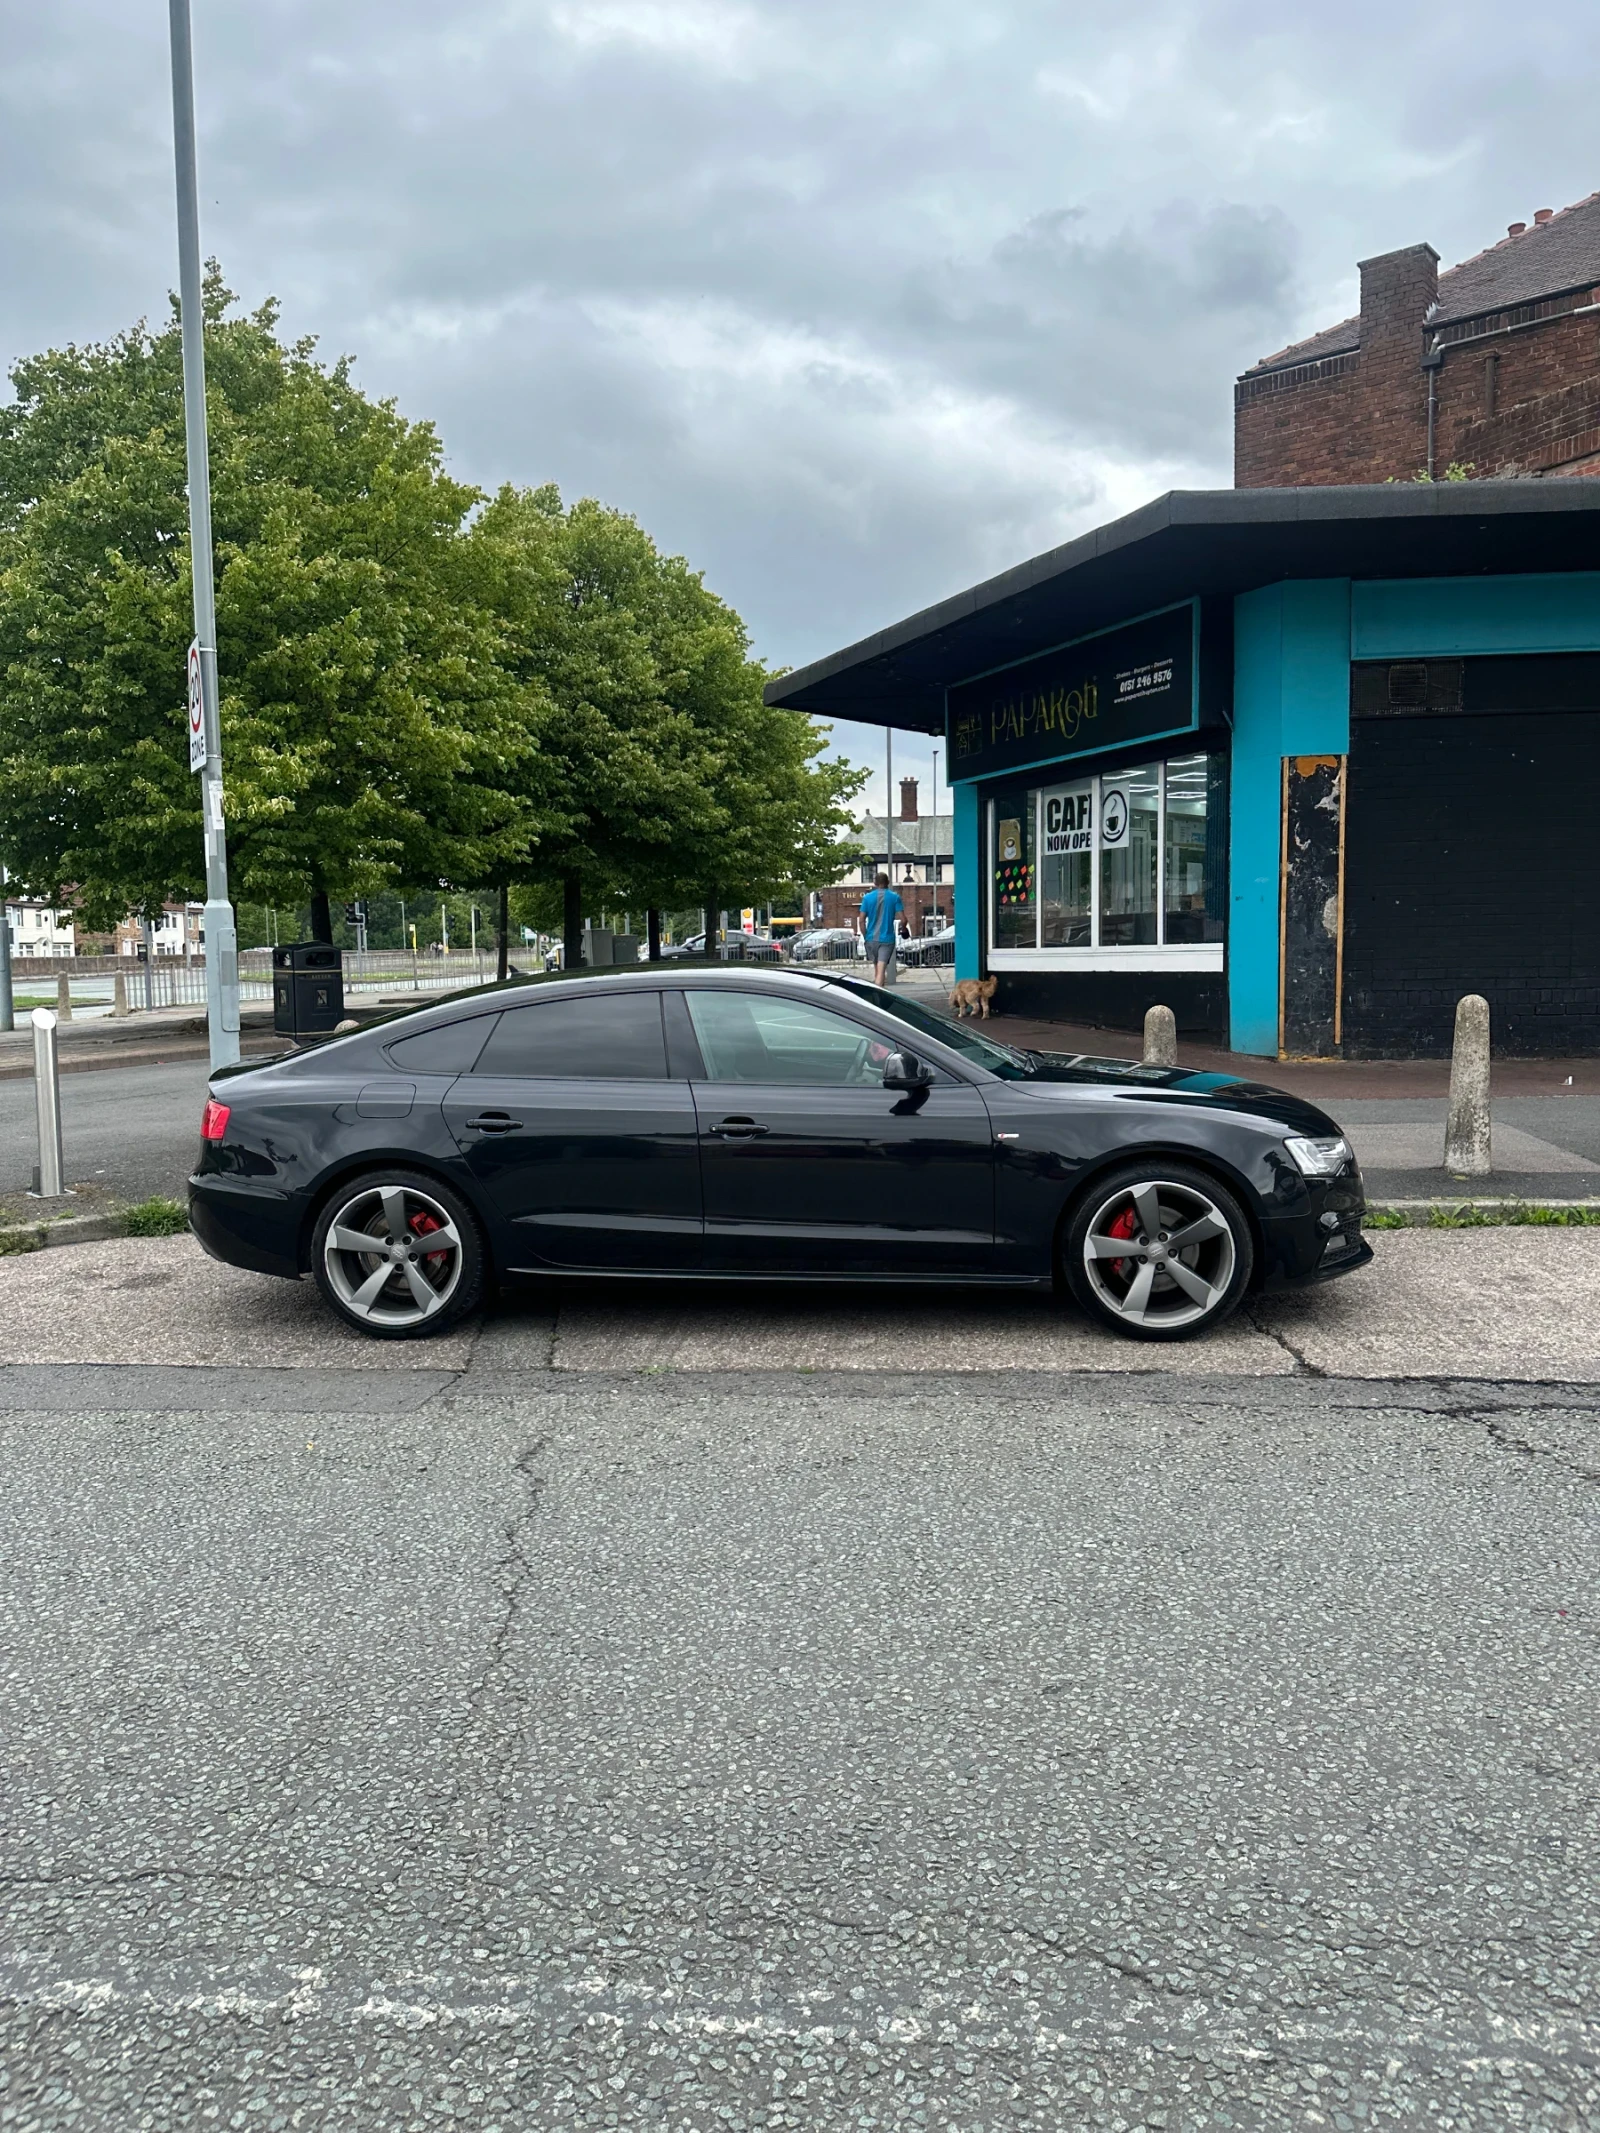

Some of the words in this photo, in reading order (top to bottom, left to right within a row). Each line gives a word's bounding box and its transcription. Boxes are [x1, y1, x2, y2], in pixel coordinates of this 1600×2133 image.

[191, 671, 199, 710] 20
[1120, 678, 1136, 693] 0151
[1136, 673, 1152, 689] 246
[1153, 668, 1173, 684] 9576
[192, 735, 204, 762] ZONE
[1046, 834, 1071, 852] NOW
[1072, 831, 1092, 850] OPE
